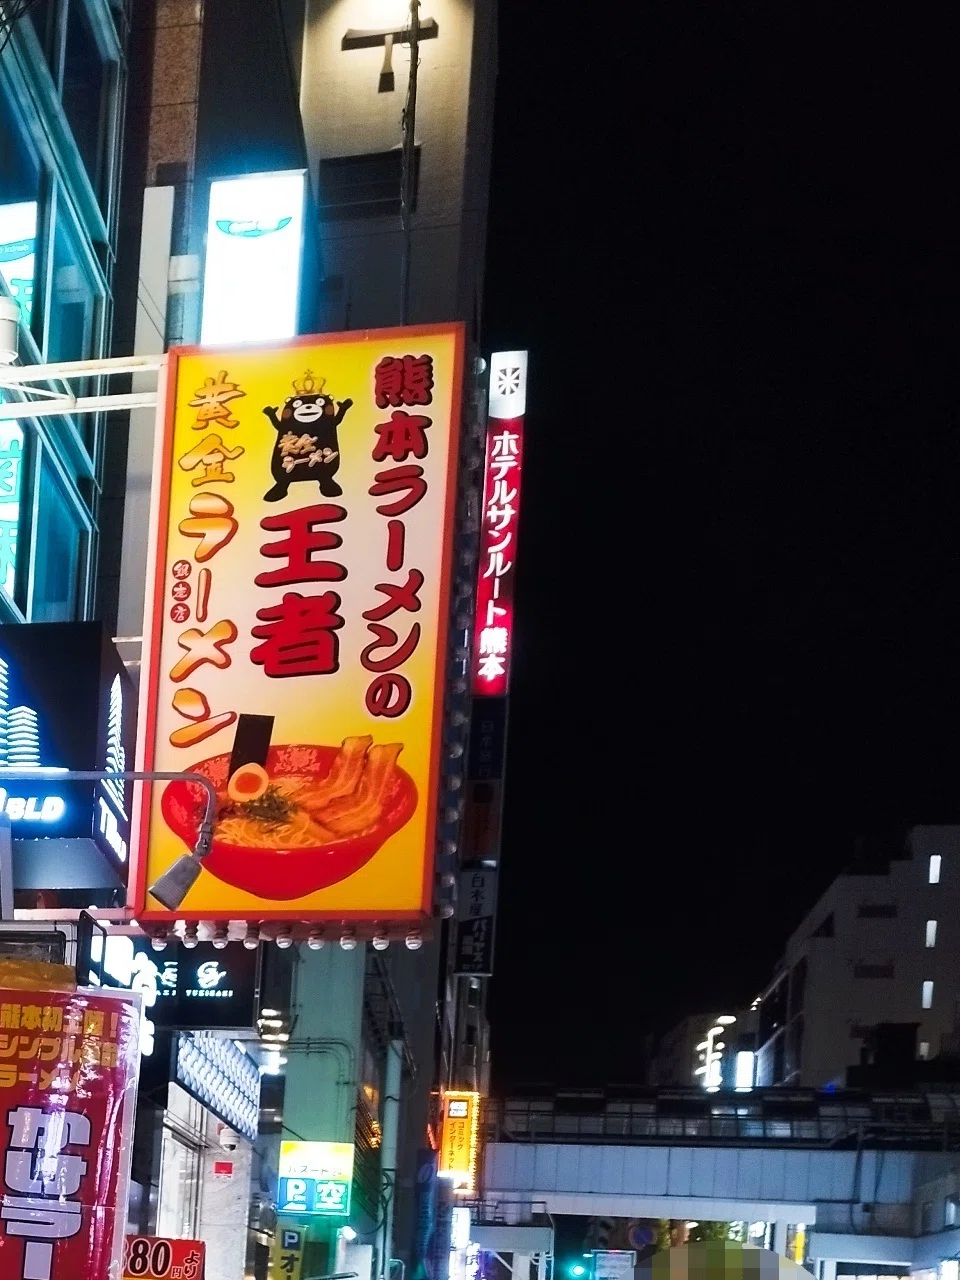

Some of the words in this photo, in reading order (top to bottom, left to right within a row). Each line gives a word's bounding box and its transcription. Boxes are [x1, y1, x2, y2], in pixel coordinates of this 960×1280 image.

[281, 447, 339, 473] ラーメン
[360, 354, 435, 718] 熊本ラーメンの
[169, 370, 248, 748] 黄金ラーメン
[250, 503, 348, 678] 王者
[478, 430, 520, 680] ホテルサンルート熊本
[284, 1231, 299, 1249] P
[315, 1181, 346, 1210] 空
